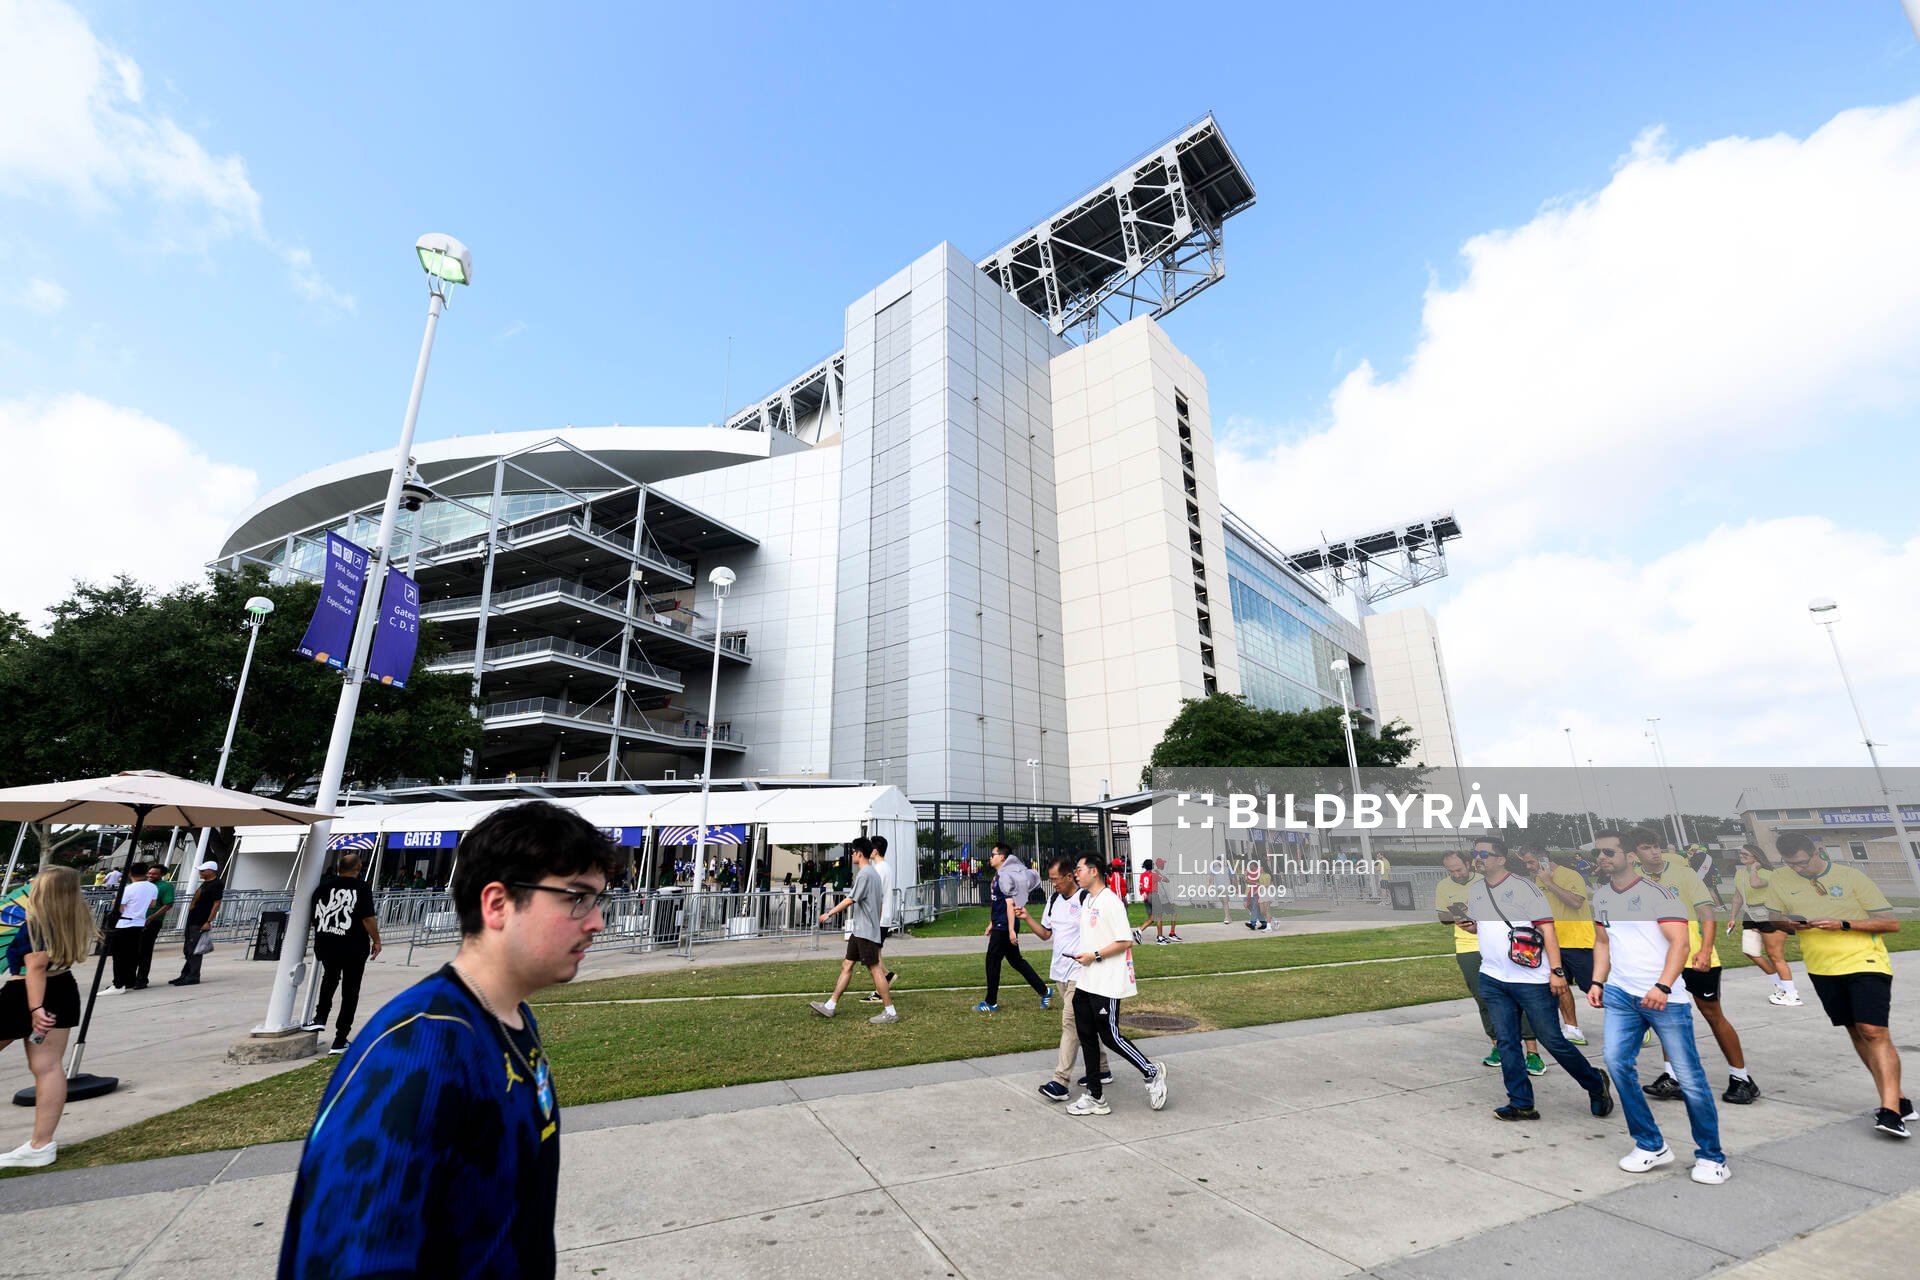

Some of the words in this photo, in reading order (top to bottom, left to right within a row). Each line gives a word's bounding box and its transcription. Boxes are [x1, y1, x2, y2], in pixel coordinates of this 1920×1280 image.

[334, 561, 346, 573] FIFA
[346, 569, 359, 582] Store
[337, 579, 356, 596] Stadium
[326, 595, 352, 616] Experience
[343, 595, 354, 606] Fan
[394, 605, 416, 621] Gates
[410, 623, 415, 633] E
[1831, 813, 1870, 823] TICKET
[403, 831, 433, 847] GATE
[432, 831, 442, 847] B
